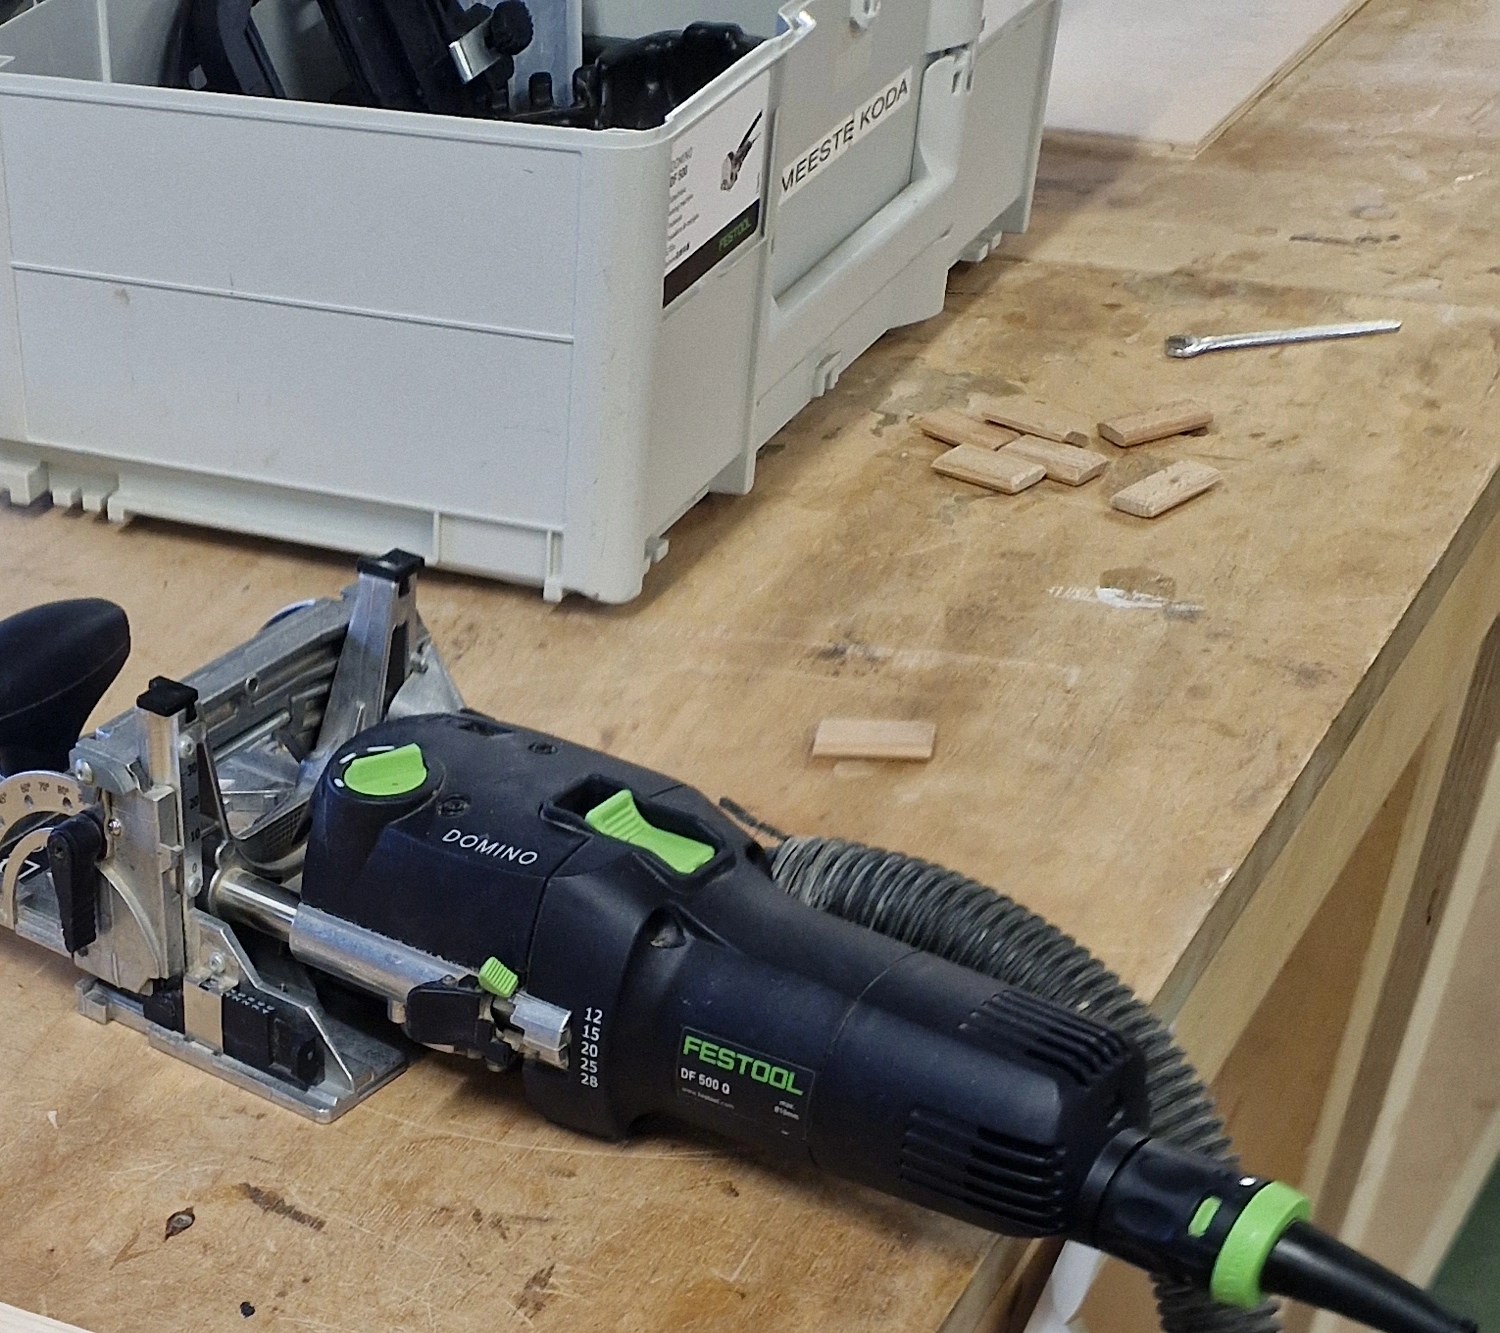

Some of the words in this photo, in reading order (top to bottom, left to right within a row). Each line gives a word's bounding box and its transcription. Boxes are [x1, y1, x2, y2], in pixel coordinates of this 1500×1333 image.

[782, 119, 854, 192] MEESTE
[860, 78, 907, 130] KODA
[442, 828, 538, 865] DOMINO
[584, 1007, 603, 1025] 12
[582, 1024, 600, 1041] 15
[581, 1041, 598, 1058] 20
[580, 1058, 598, 1073] 25
[683, 1035, 804, 1096] FESTOOL
[580, 1072, 598, 1088] 28
[681, 1067, 696, 1081] DF
[699, 1074, 719, 1091] 500
